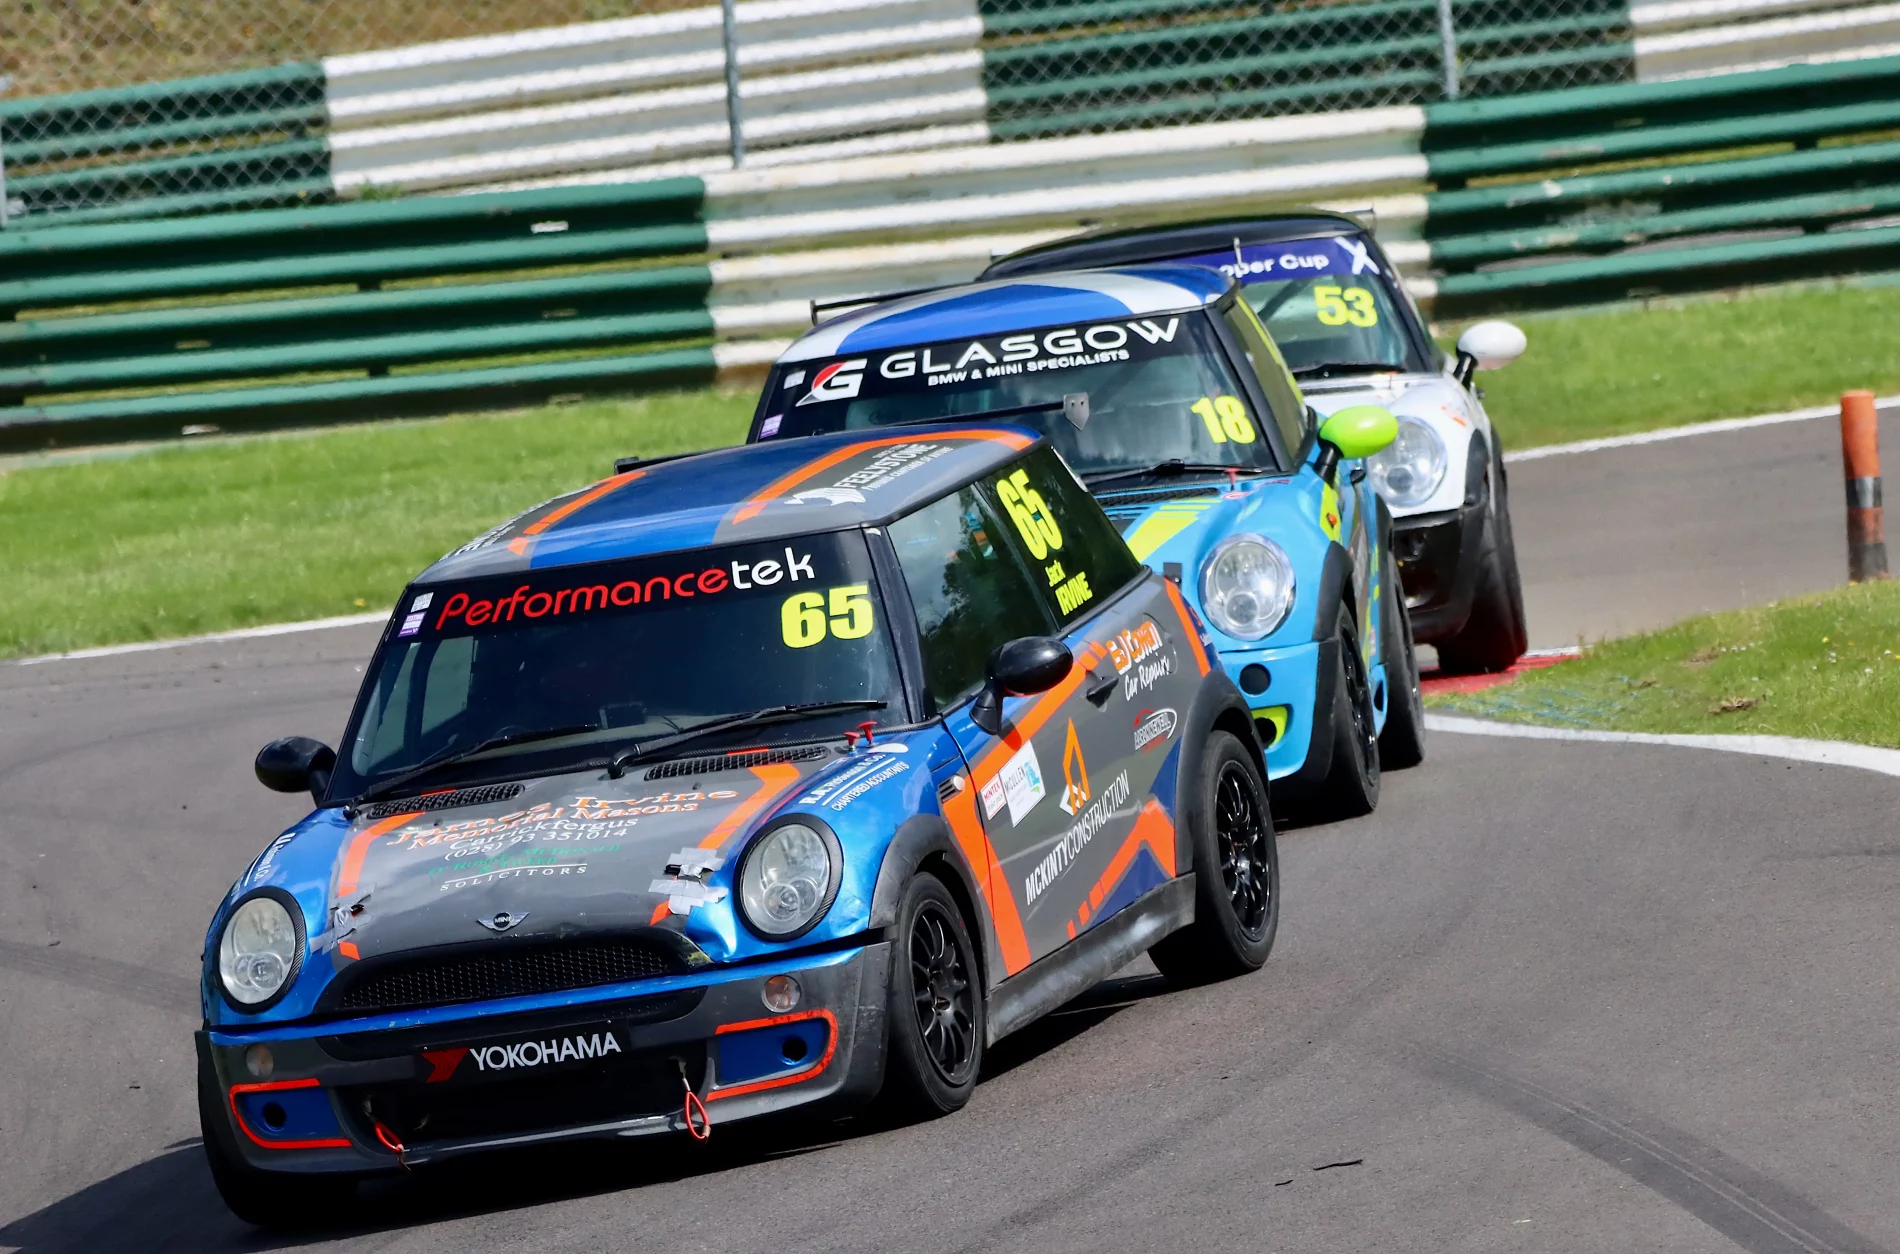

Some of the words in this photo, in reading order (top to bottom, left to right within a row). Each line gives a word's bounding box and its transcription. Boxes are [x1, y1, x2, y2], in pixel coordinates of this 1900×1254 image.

[1279, 253, 1329, 270] Cup
[1314, 285, 1378, 327] 53
[880, 317, 1180, 379] GLASGOW
[928, 370, 968, 387] BMW
[970, 368, 983, 380] &
[986, 364, 1023, 379] MINI
[1026, 349, 1130, 372] SPECIALISTS
[1190, 395, 1256, 444] 18
[996, 468, 1063, 560] 65
[1055, 571, 1094, 616] IRVINE
[780, 584, 874, 649] 65
[1124, 674, 1139, 701] Car
[831, 782, 871, 811] CHARTERED
[867, 761, 910, 788] ACCOUNTANTS
[386, 802, 552, 846] James
[568, 790, 739, 809] Irvine
[406, 807, 564, 851] Memorial
[569, 802, 699, 820] Masons
[449, 818, 639, 851] Carrickfergus
[444, 841, 503, 861] (028)
[509, 832, 536, 846] 93
[542, 827, 628, 841] 351014
[439, 865, 588, 892] SOLICITORS
[469, 1031, 622, 1071] YOKOHAMA
